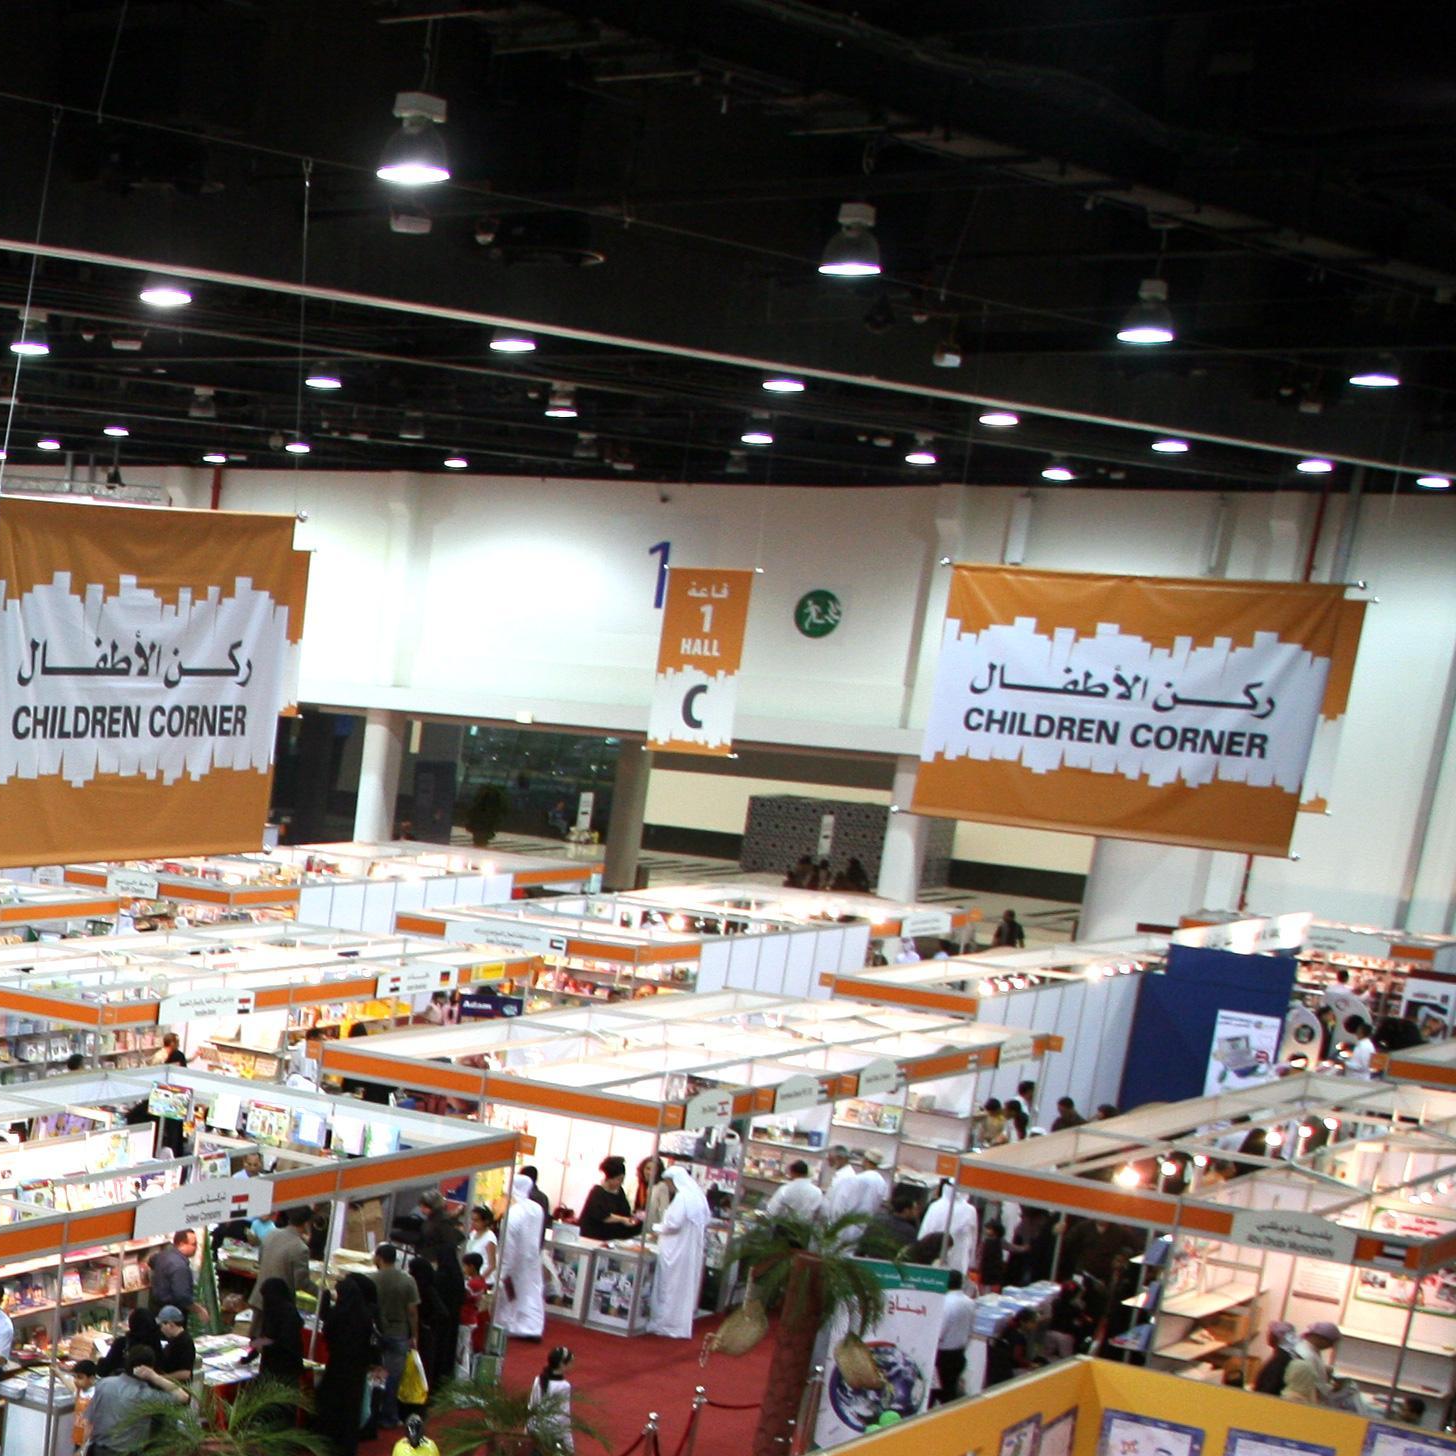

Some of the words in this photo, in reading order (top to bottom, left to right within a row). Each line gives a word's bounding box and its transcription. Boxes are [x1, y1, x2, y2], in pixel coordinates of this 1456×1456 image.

[648, 540, 672, 609] 1
[687, 580, 730, 600] قاعة
[701, 604, 712, 633] 1
[18, 629, 161, 688] الأطفال
[163, 639, 253, 688] ركن
[680, 637, 721, 658] HALL
[681, 684, 709, 729] C
[970, 660, 1152, 709] الأطفال
[1154, 674, 1276, 719] ركن
[12, 704, 141, 740] CHILDREN
[148, 704, 248, 739] CORNER
[963, 706, 1119, 747] CHILDREN
[1129, 722, 1269, 760] CORNER
